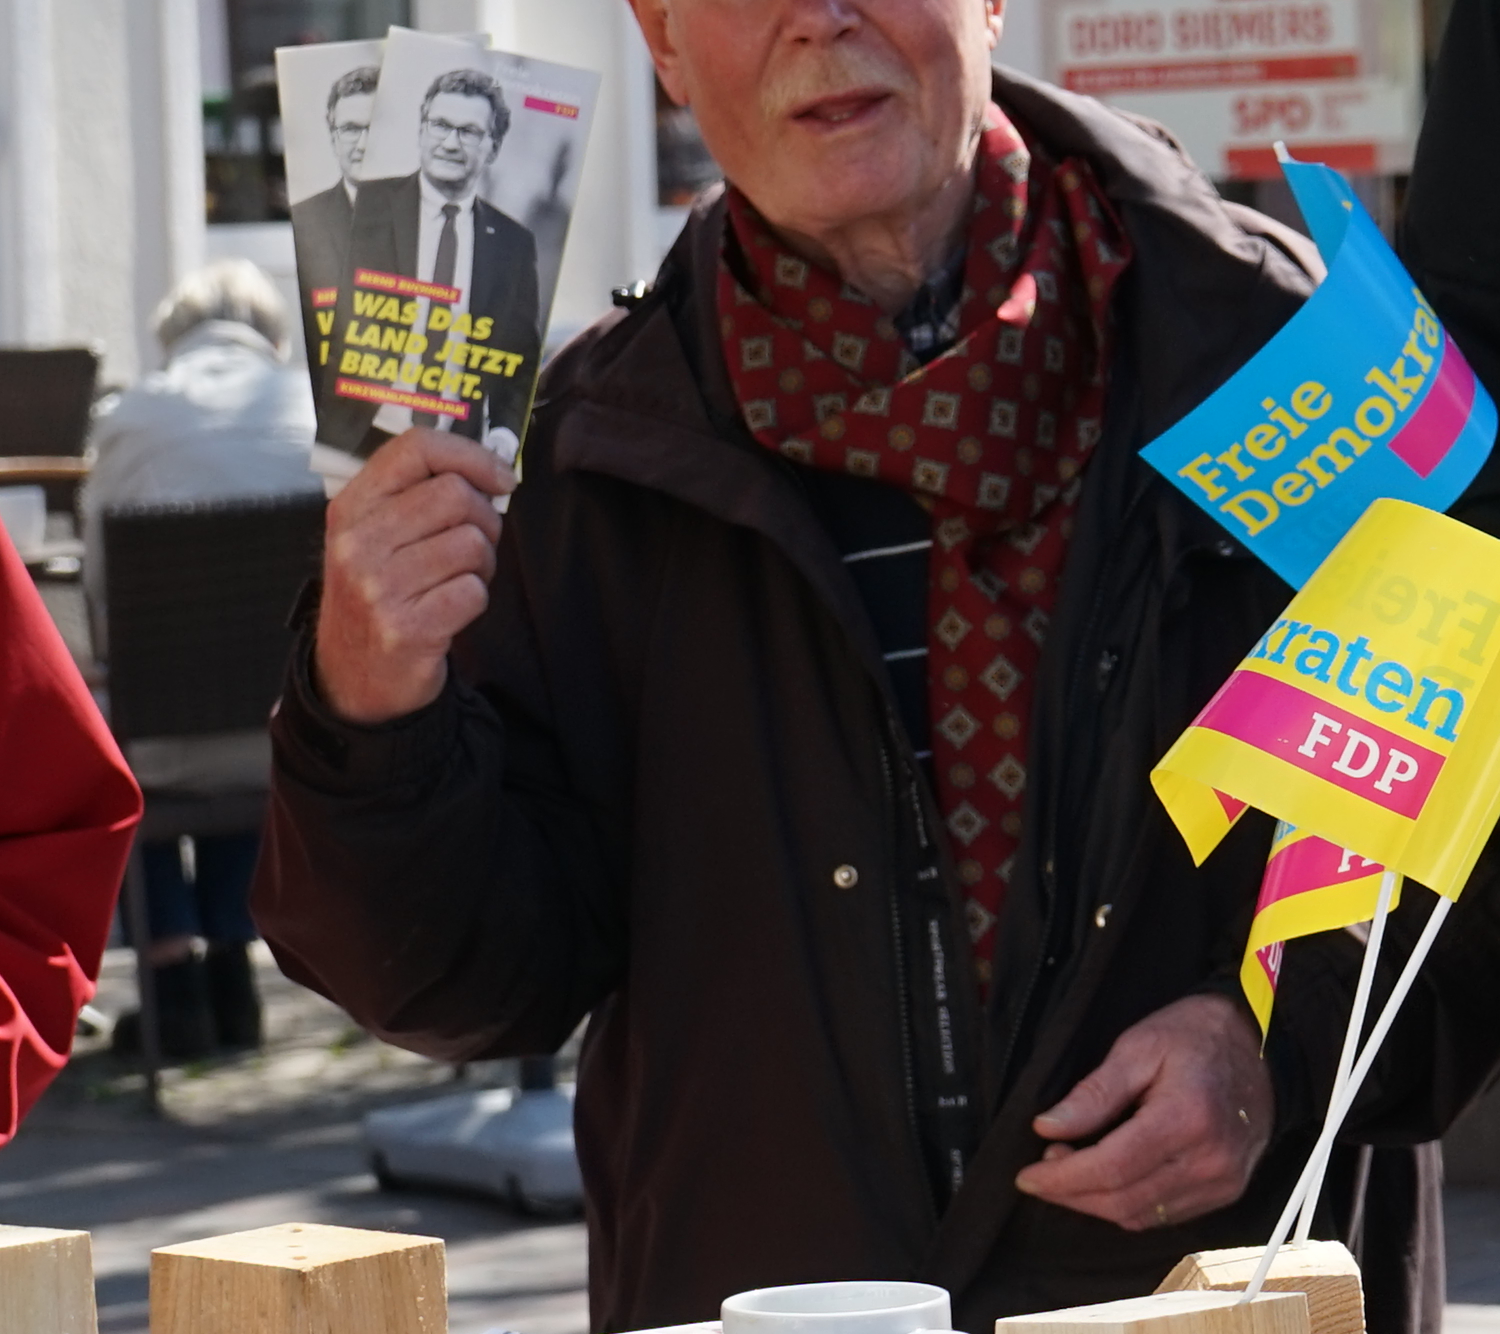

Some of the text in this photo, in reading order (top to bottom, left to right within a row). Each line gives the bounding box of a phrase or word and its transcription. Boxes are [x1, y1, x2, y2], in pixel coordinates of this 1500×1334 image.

[1070, 5, 1333, 54] DORO SIEMERS
[1234, 93, 1313, 133] SPD
[353, 290, 494, 341] WAS DAS
[338, 348, 483, 400] BRAUCHT.
[344, 320, 429, 355] LAND
[434, 339, 524, 378] JETZT
[1220, 286, 1442, 537] Demokra
[1177, 379, 1334, 503] Freie
[1297, 712, 1419, 797] FDP
